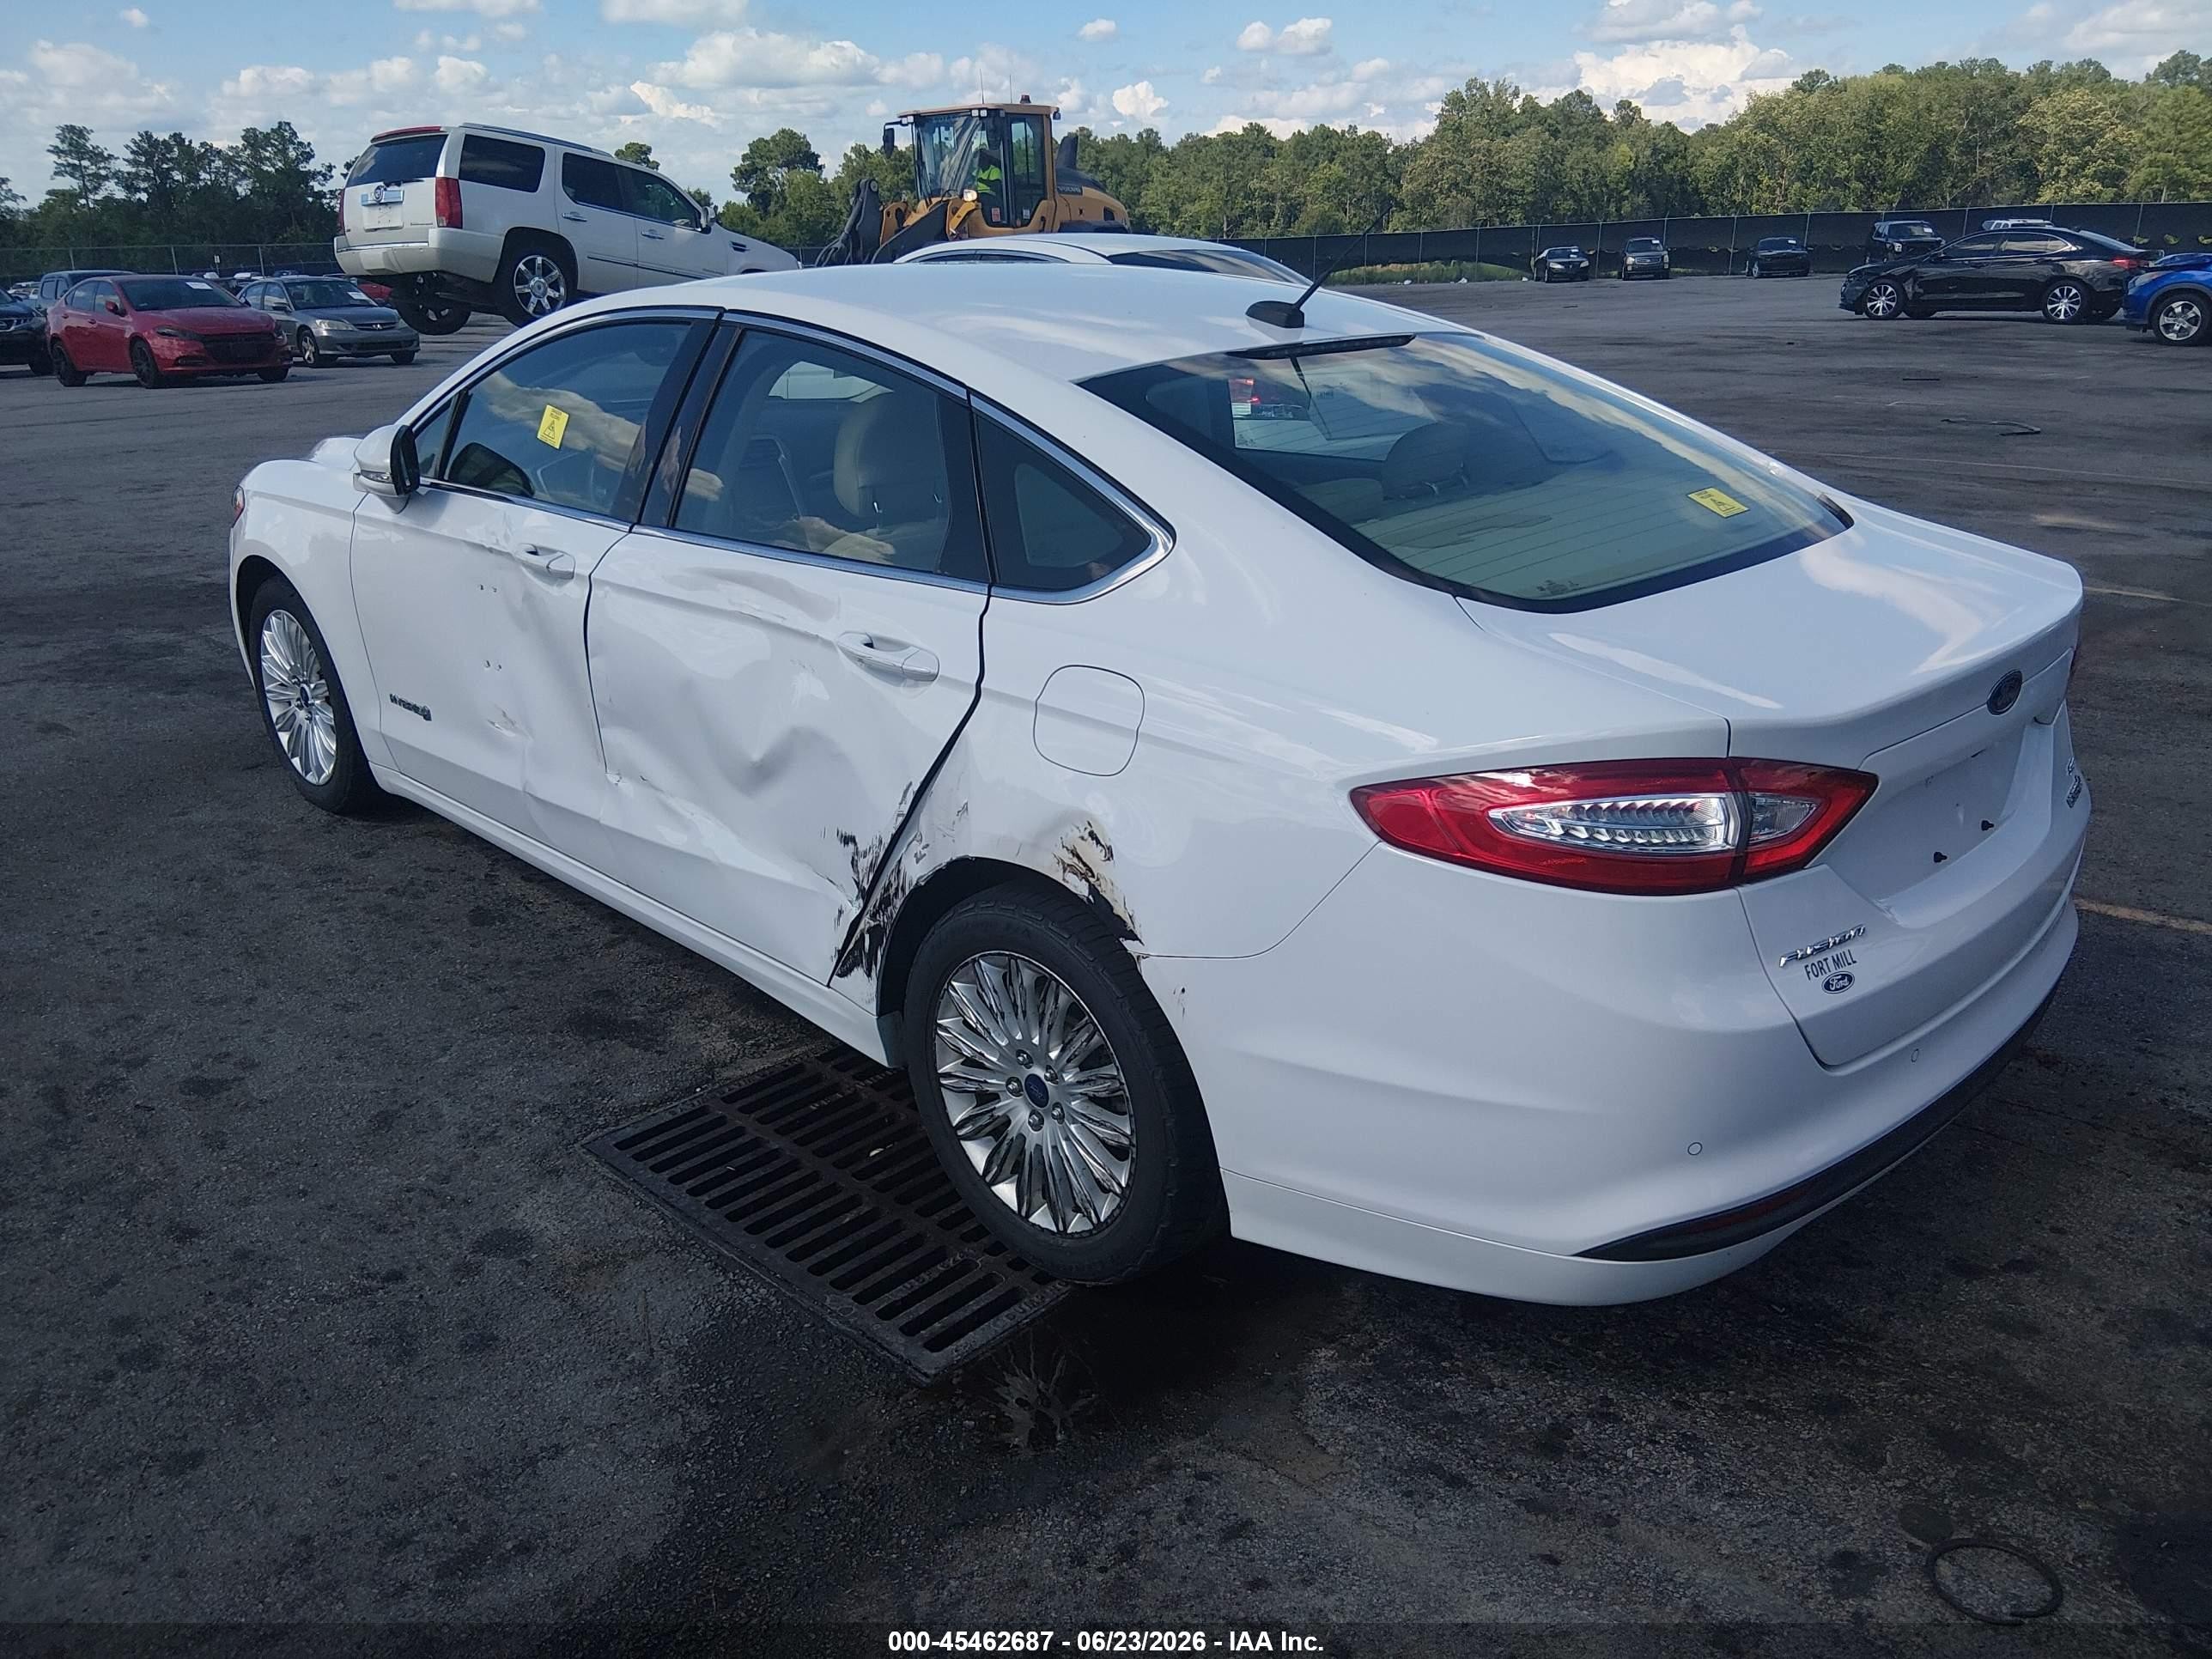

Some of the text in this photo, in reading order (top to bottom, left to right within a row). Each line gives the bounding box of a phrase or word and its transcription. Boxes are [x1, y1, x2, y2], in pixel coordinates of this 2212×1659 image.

[1804, 948, 1857, 981] FORT MILL
[1829, 975, 1850, 991] Ford
